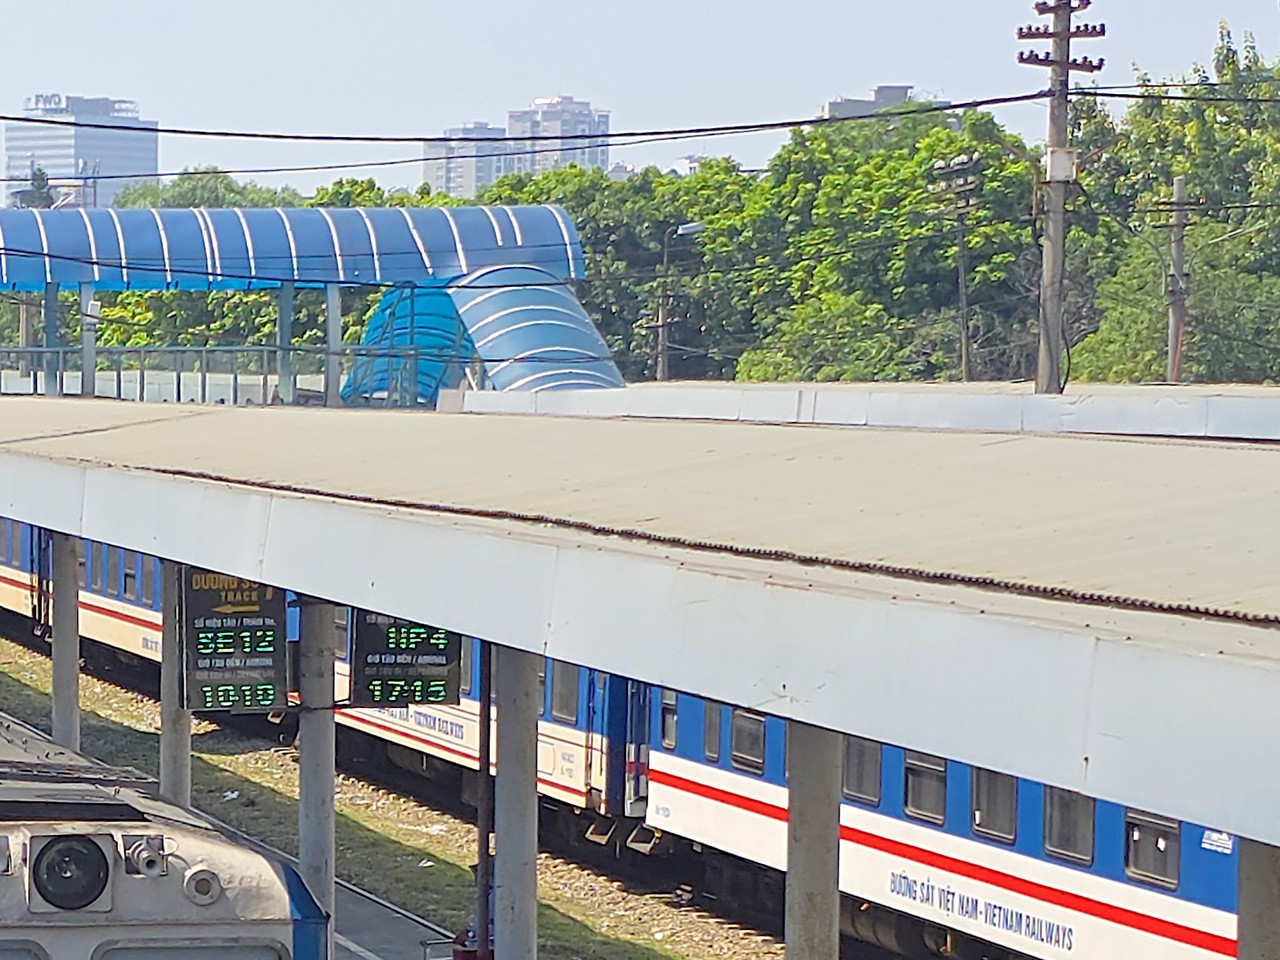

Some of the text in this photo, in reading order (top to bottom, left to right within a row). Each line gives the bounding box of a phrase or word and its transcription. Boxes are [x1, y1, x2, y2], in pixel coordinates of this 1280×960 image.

[34, 93, 61, 107] FWD
[958, 892, 979, 921] NAM
[984, 901, 1024, 936] VIETNAM
[1024, 914, 1074, 951] RAILWAYS
